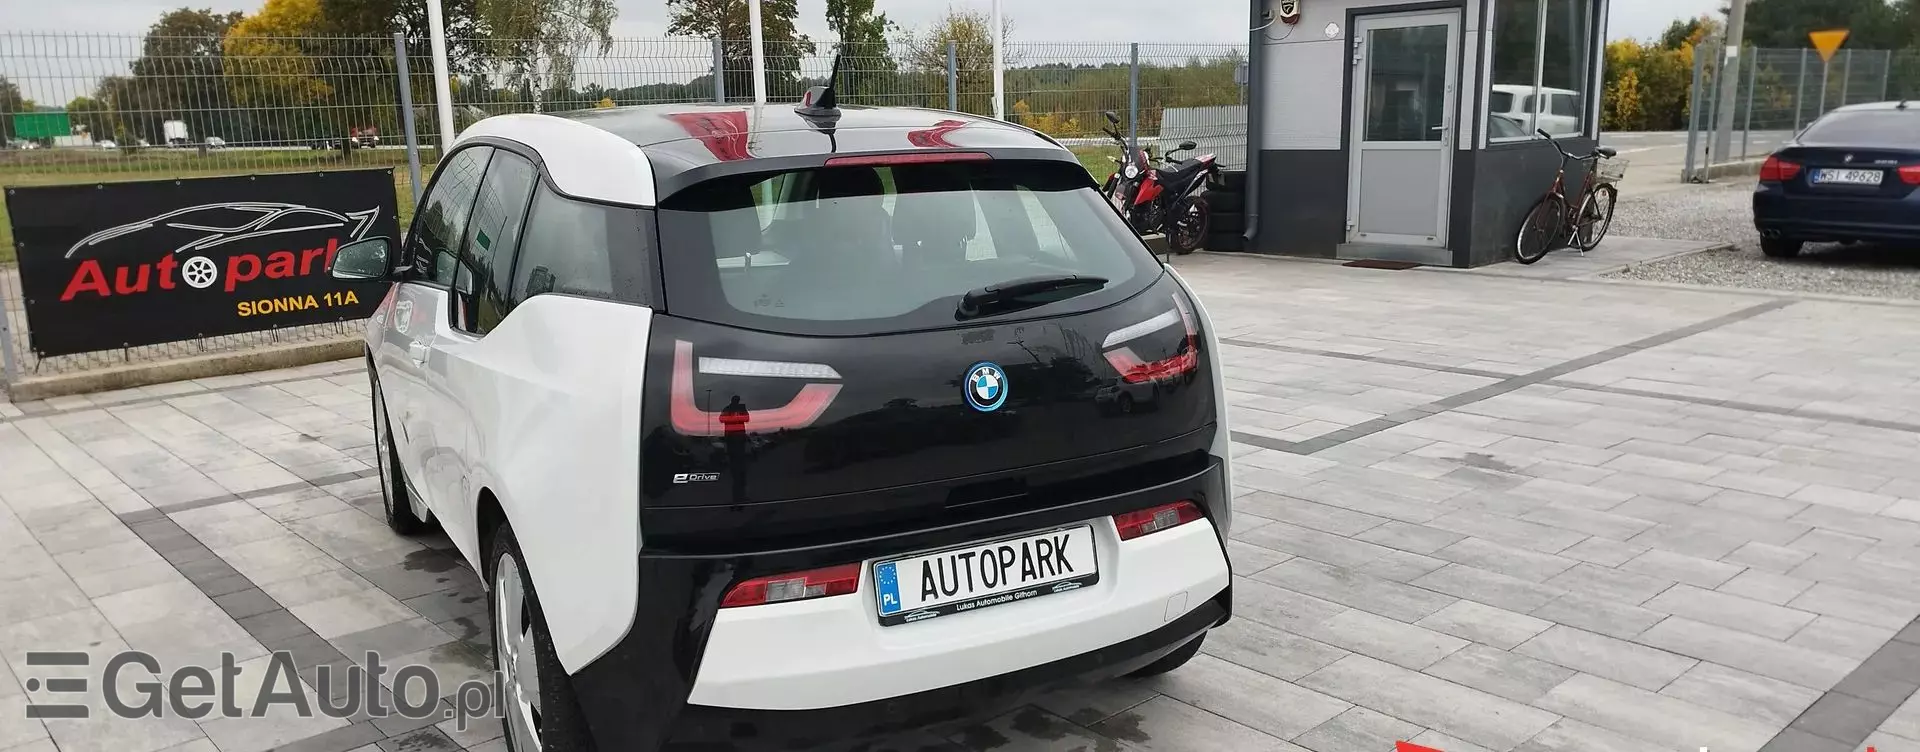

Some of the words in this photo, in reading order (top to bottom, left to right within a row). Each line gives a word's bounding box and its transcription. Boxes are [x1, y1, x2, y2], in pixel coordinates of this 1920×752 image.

[1820, 169, 1840, 181] WSI
[1845, 170, 1881, 183] 49628
[237, 294, 319, 317] SIONNA
[323, 290, 359, 308] 11A
[920, 534, 1074, 602] AUTOPARK
[883, 592, 898, 606] PL
[956, 599, 975, 611] Lukas
[976, 594, 1013, 608] Automobile
